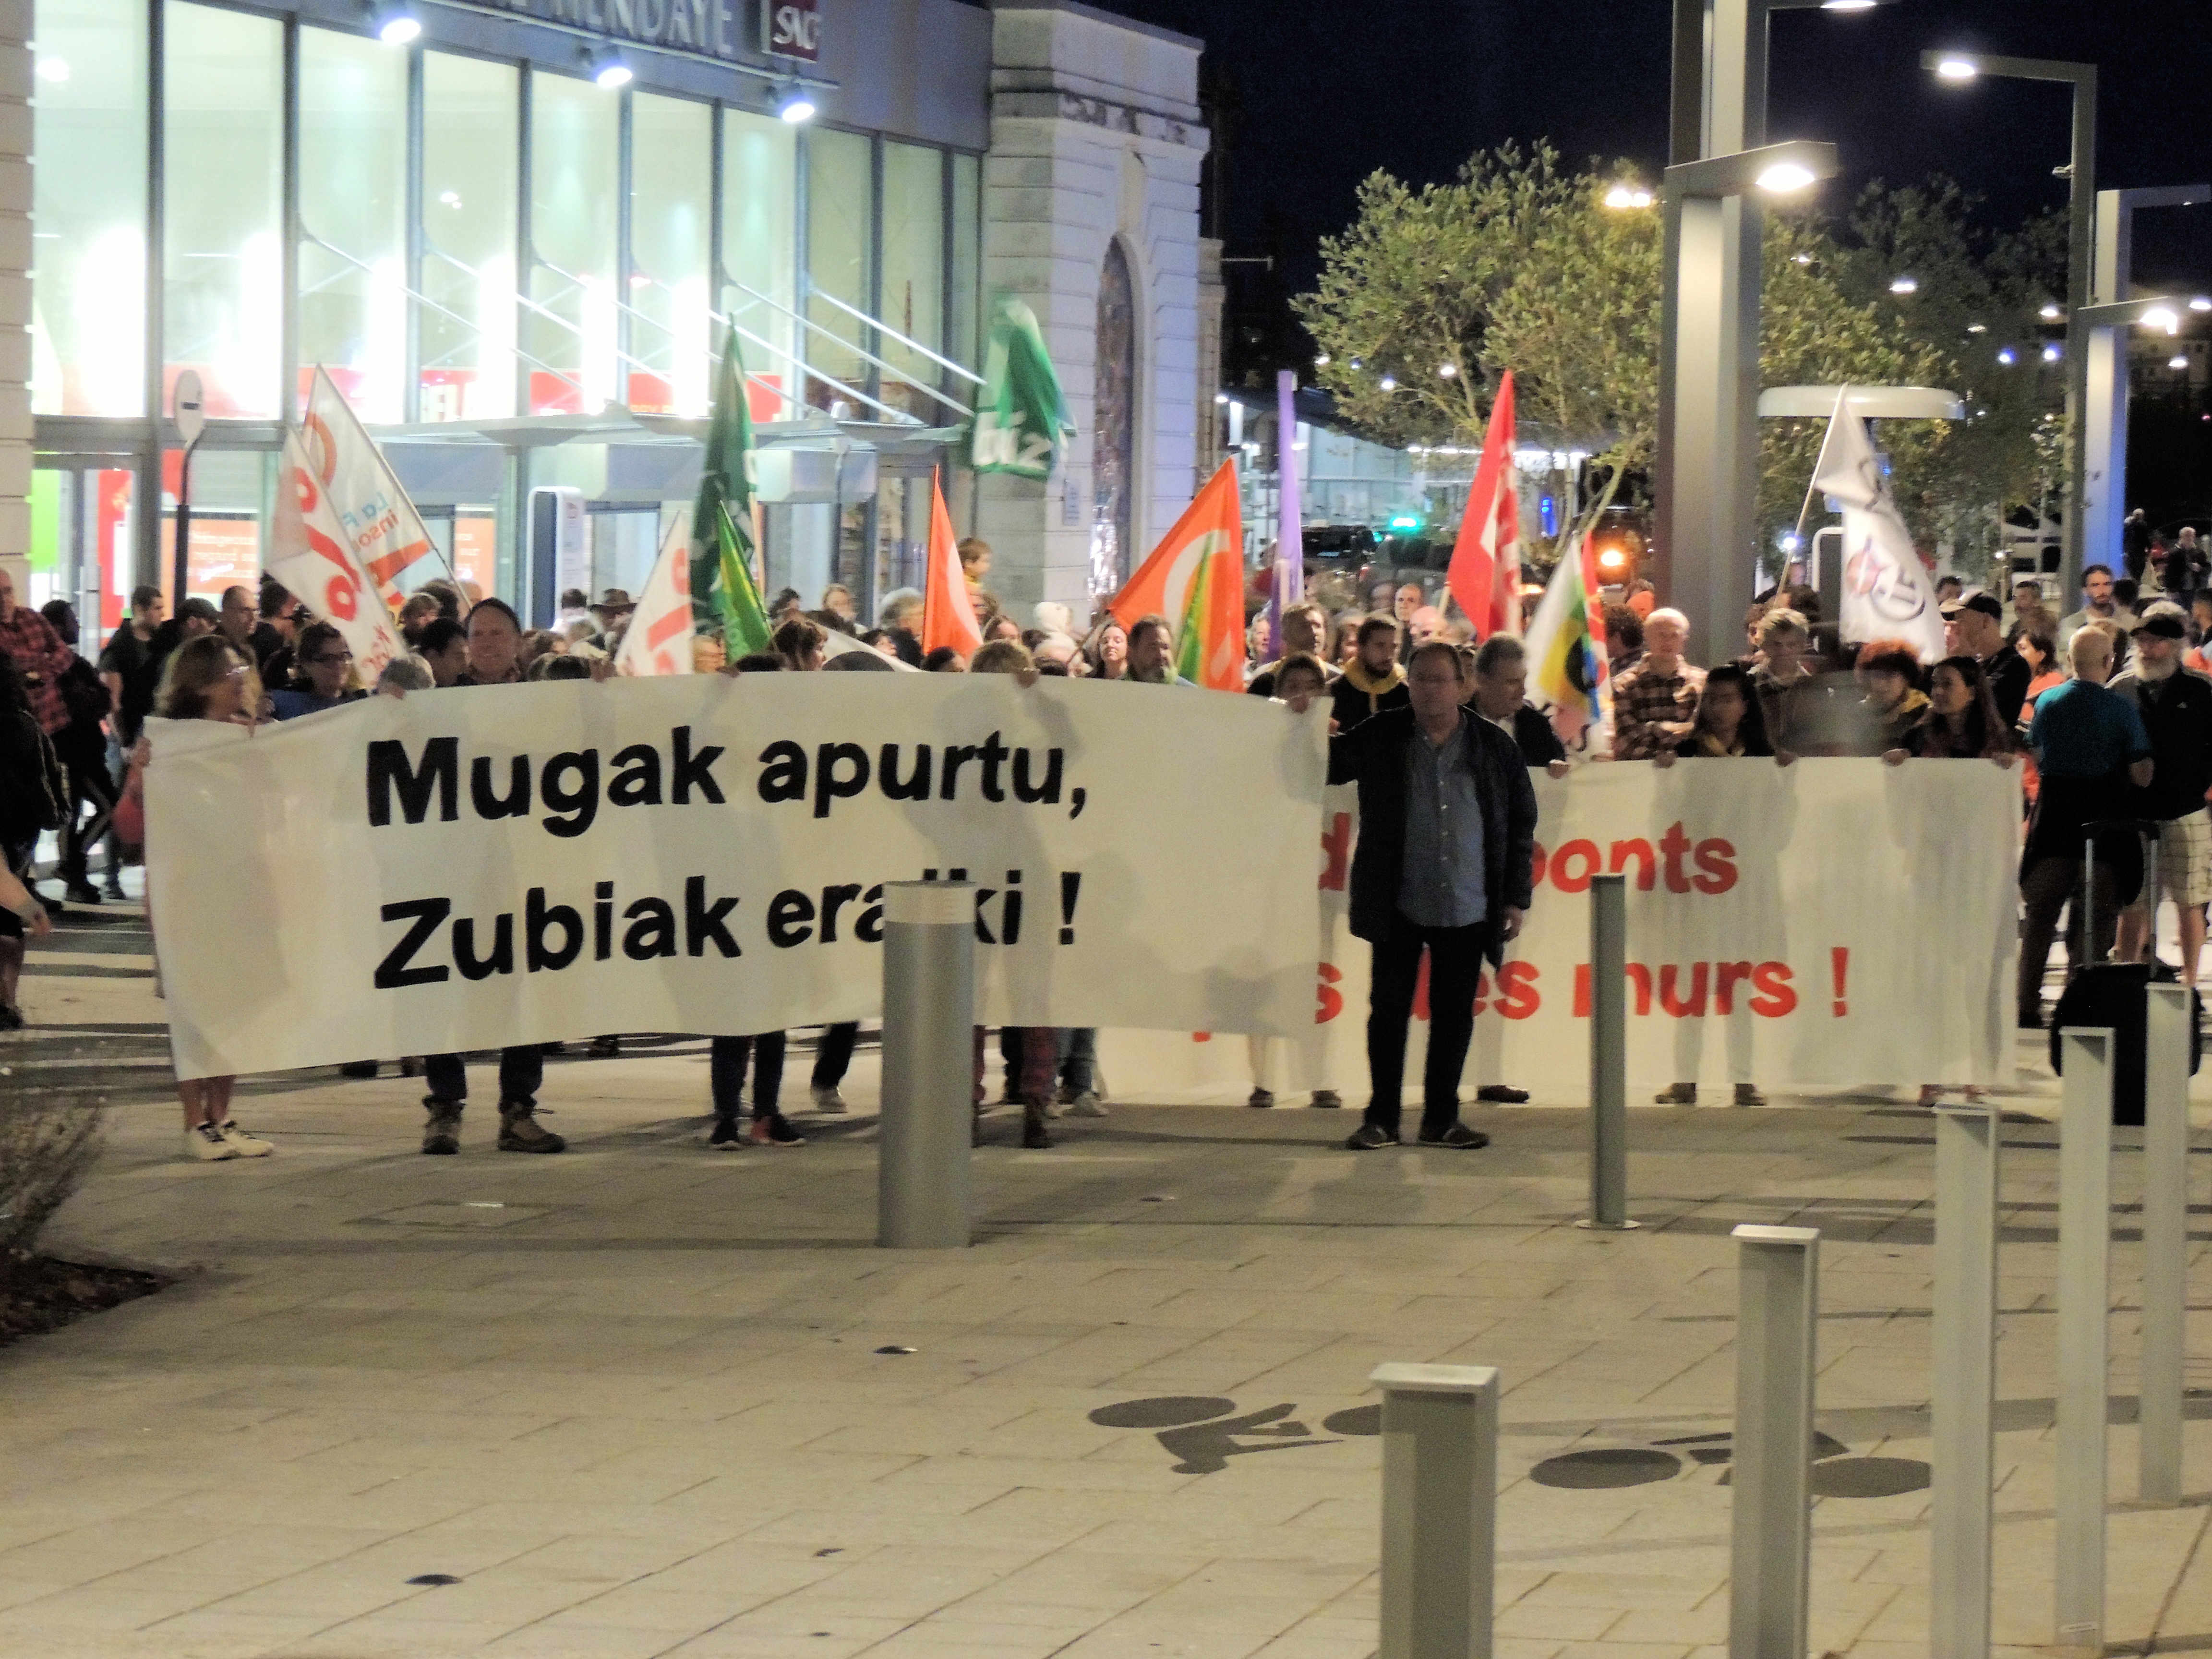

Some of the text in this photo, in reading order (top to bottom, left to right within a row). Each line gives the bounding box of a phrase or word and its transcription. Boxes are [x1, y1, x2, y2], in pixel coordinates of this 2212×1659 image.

[554, 0, 733, 54] NDAYE
[366, 724, 1087, 839] Mugak apurtu,
[1531, 820, 1739, 895] onts
[373, 867, 1082, 990] Zubiak eraki !
[1571, 960, 1799, 1019] murs
[1830, 945, 1850, 1019] !
